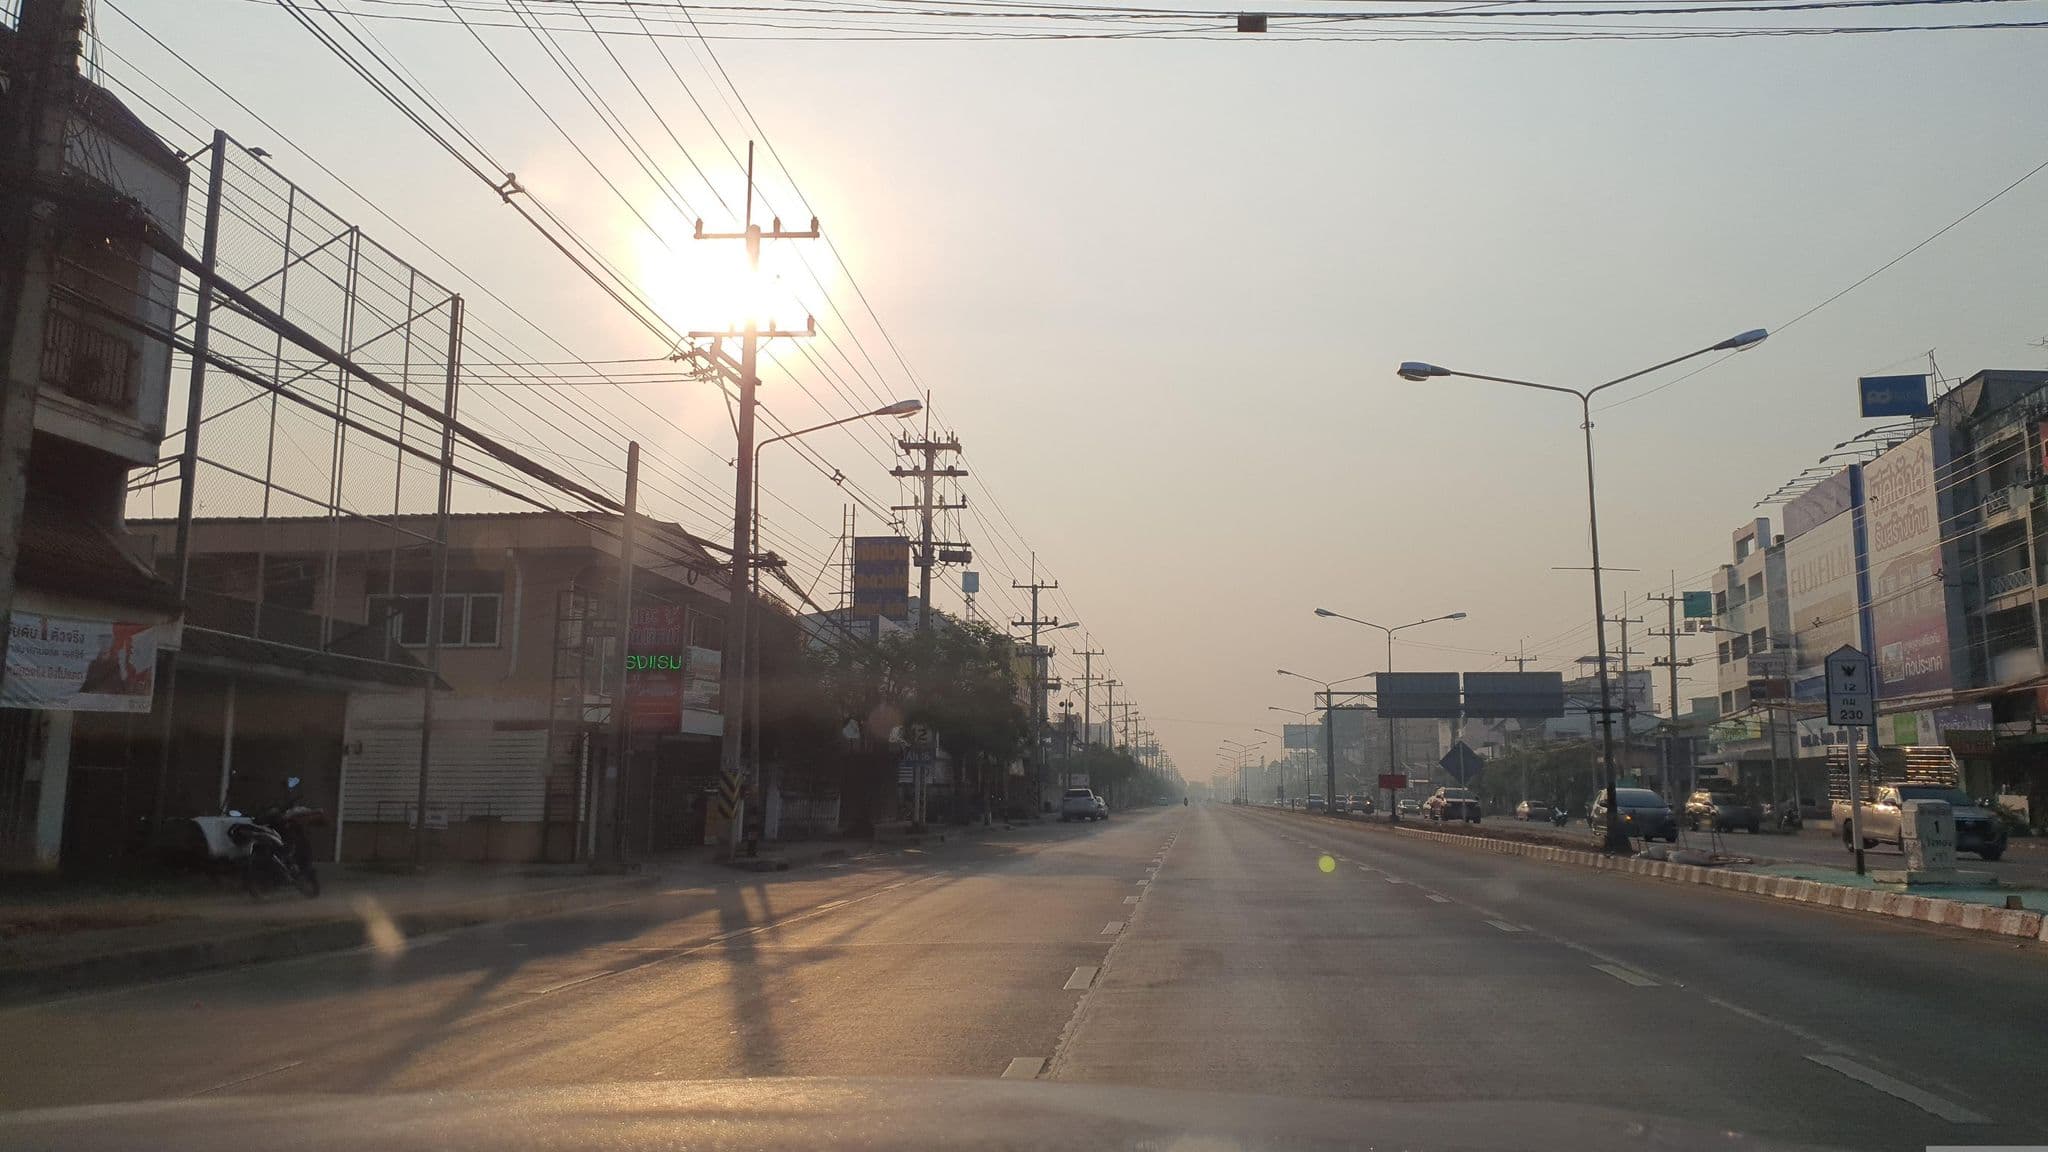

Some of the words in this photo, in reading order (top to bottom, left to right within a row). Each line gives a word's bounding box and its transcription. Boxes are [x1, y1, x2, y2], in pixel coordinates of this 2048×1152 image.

[1791, 544, 1850, 598] FUJIFILM
[1844, 683, 1857, 691] 12
[1840, 709, 1863, 720] 230
